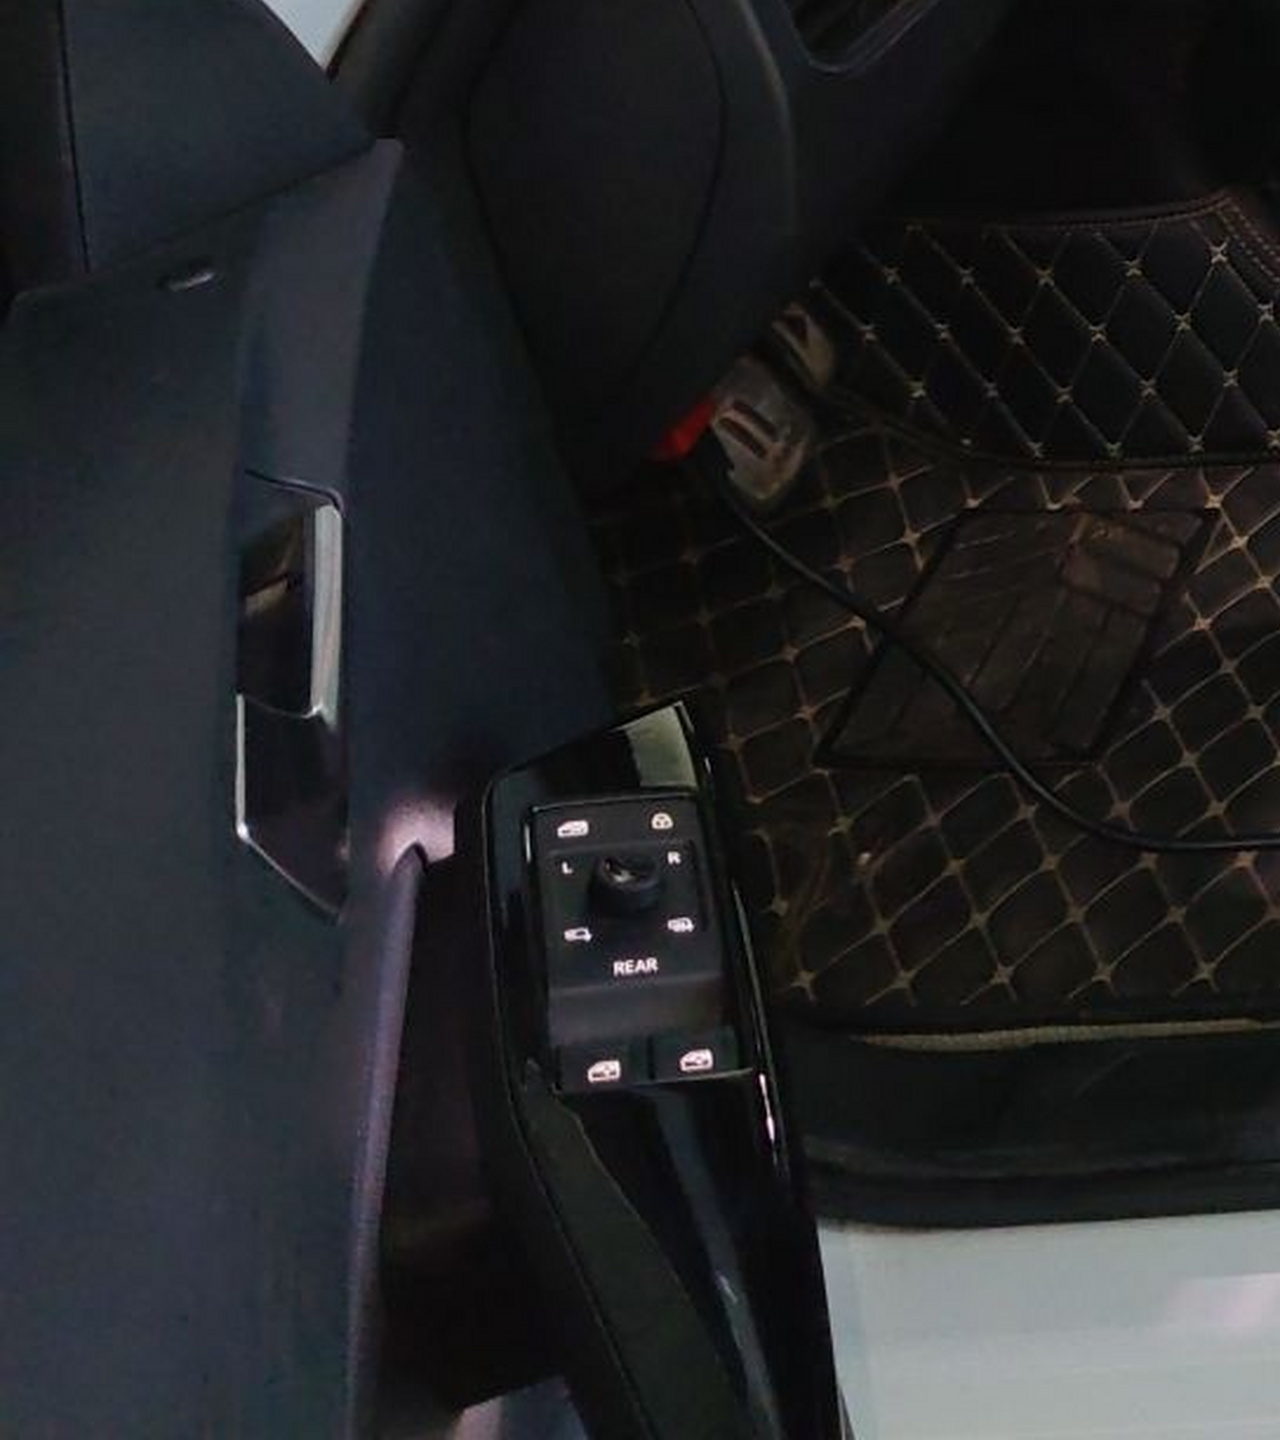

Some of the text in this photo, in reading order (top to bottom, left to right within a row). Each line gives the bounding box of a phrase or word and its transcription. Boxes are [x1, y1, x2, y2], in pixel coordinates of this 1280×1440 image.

[667, 850, 682, 865] R
[561, 861, 574, 875] L
[613, 957, 658, 976] REAR
